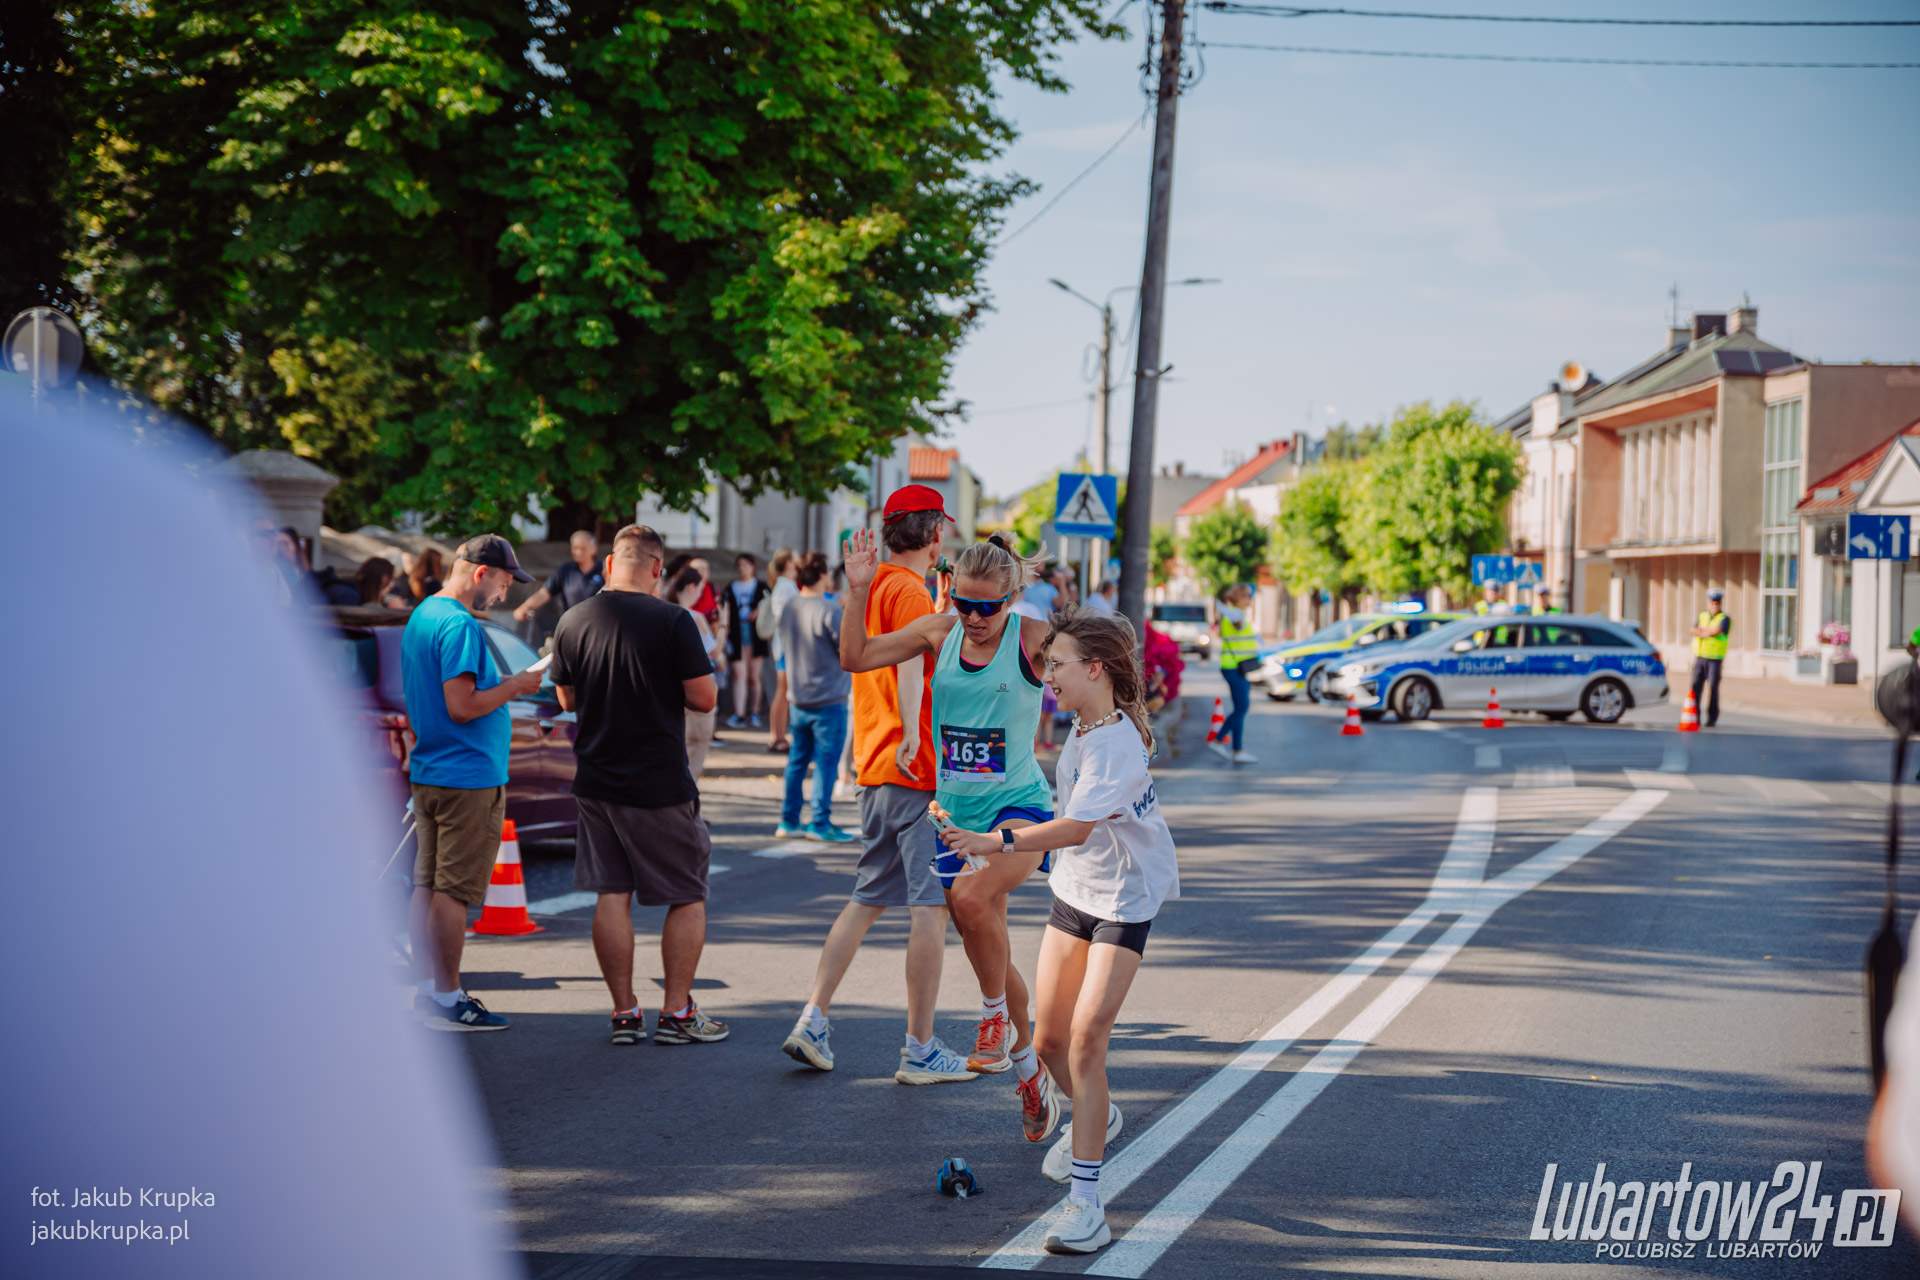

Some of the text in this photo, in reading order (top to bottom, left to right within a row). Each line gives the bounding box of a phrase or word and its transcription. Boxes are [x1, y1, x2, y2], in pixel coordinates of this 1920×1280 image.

[1457, 659, 1505, 673] POLICJA
[950, 741, 990, 763] 163
[460, 1010, 479, 1023] N
